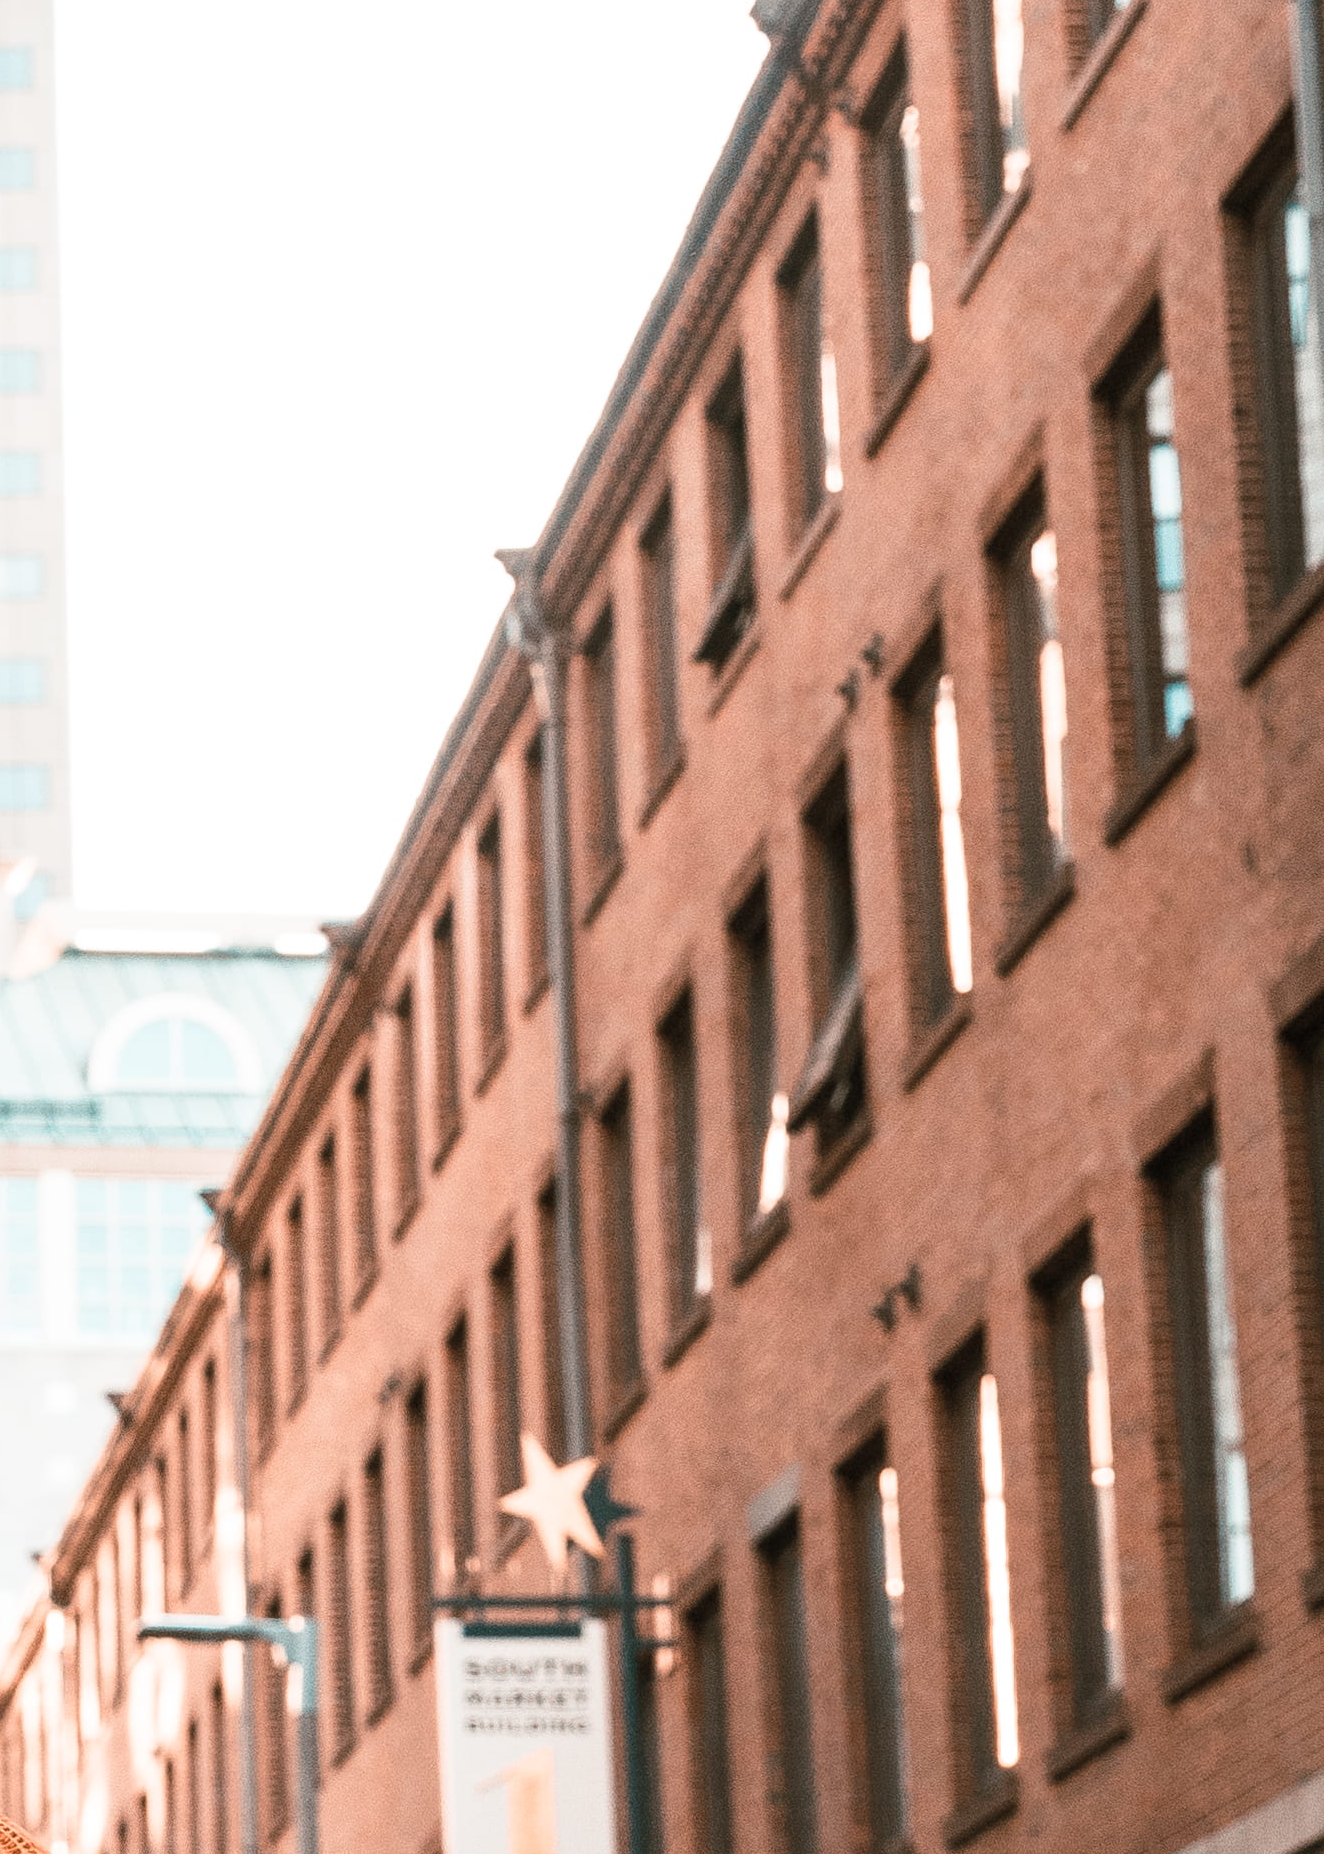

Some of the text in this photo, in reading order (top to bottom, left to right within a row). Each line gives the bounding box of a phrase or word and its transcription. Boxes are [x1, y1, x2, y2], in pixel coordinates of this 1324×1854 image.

[465, 1657, 588, 1682] SOUTH
[465, 1687, 589, 1710] MARKET
[464, 1715, 590, 1735] BUILDING
